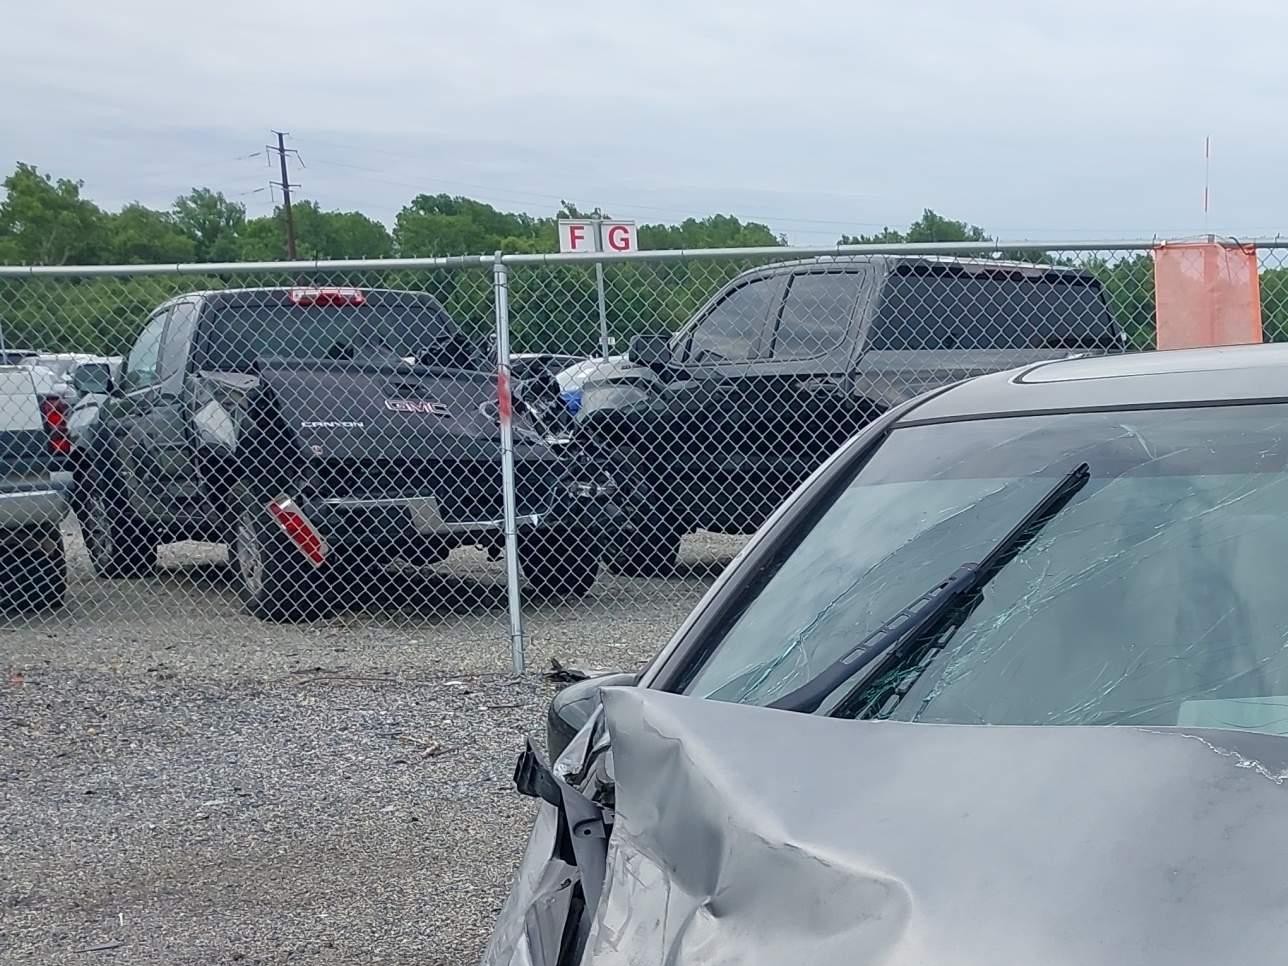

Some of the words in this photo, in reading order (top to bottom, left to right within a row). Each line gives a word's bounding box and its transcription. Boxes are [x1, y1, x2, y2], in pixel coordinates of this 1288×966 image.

[569, 225, 585, 250] F
[608, 225, 631, 251] G
[385, 400, 451, 417] GMC
